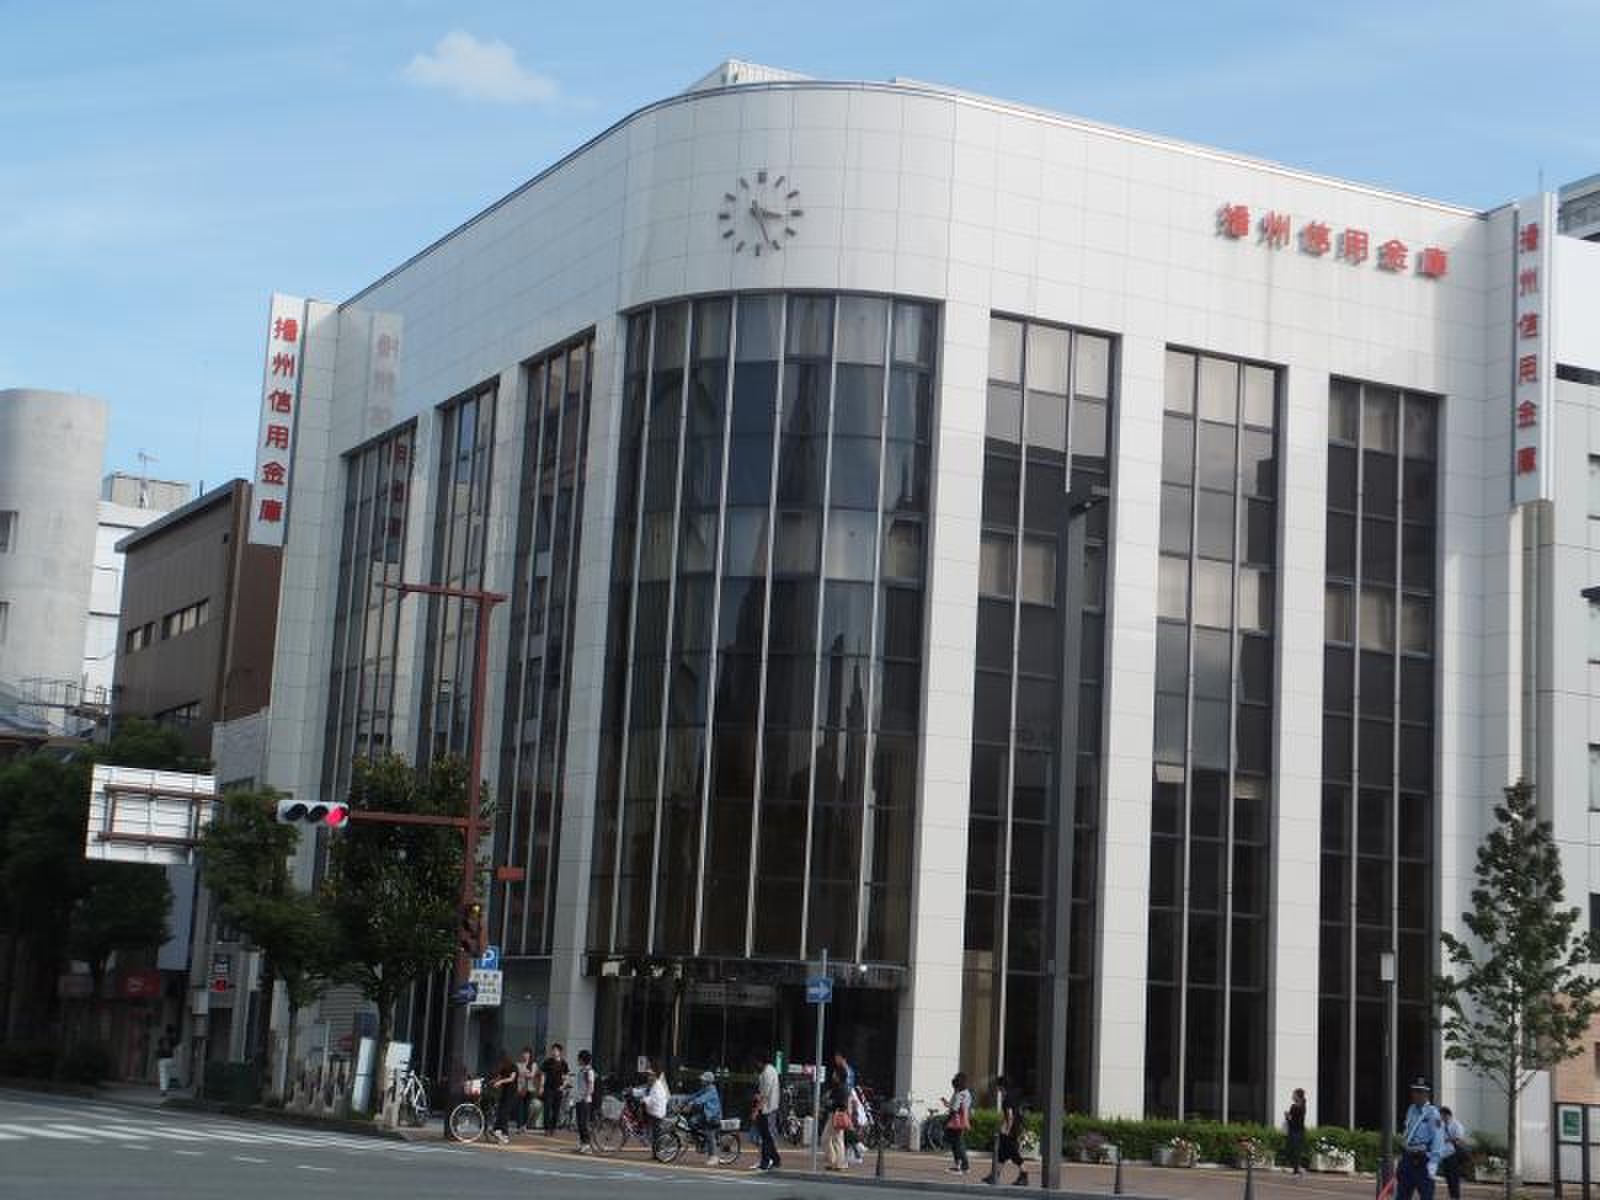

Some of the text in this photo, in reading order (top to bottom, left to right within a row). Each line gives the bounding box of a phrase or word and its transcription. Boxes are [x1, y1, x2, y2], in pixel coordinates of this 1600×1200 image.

[259, 317, 299, 523] 播州信用金庫
[481, 949, 496, 967] P
